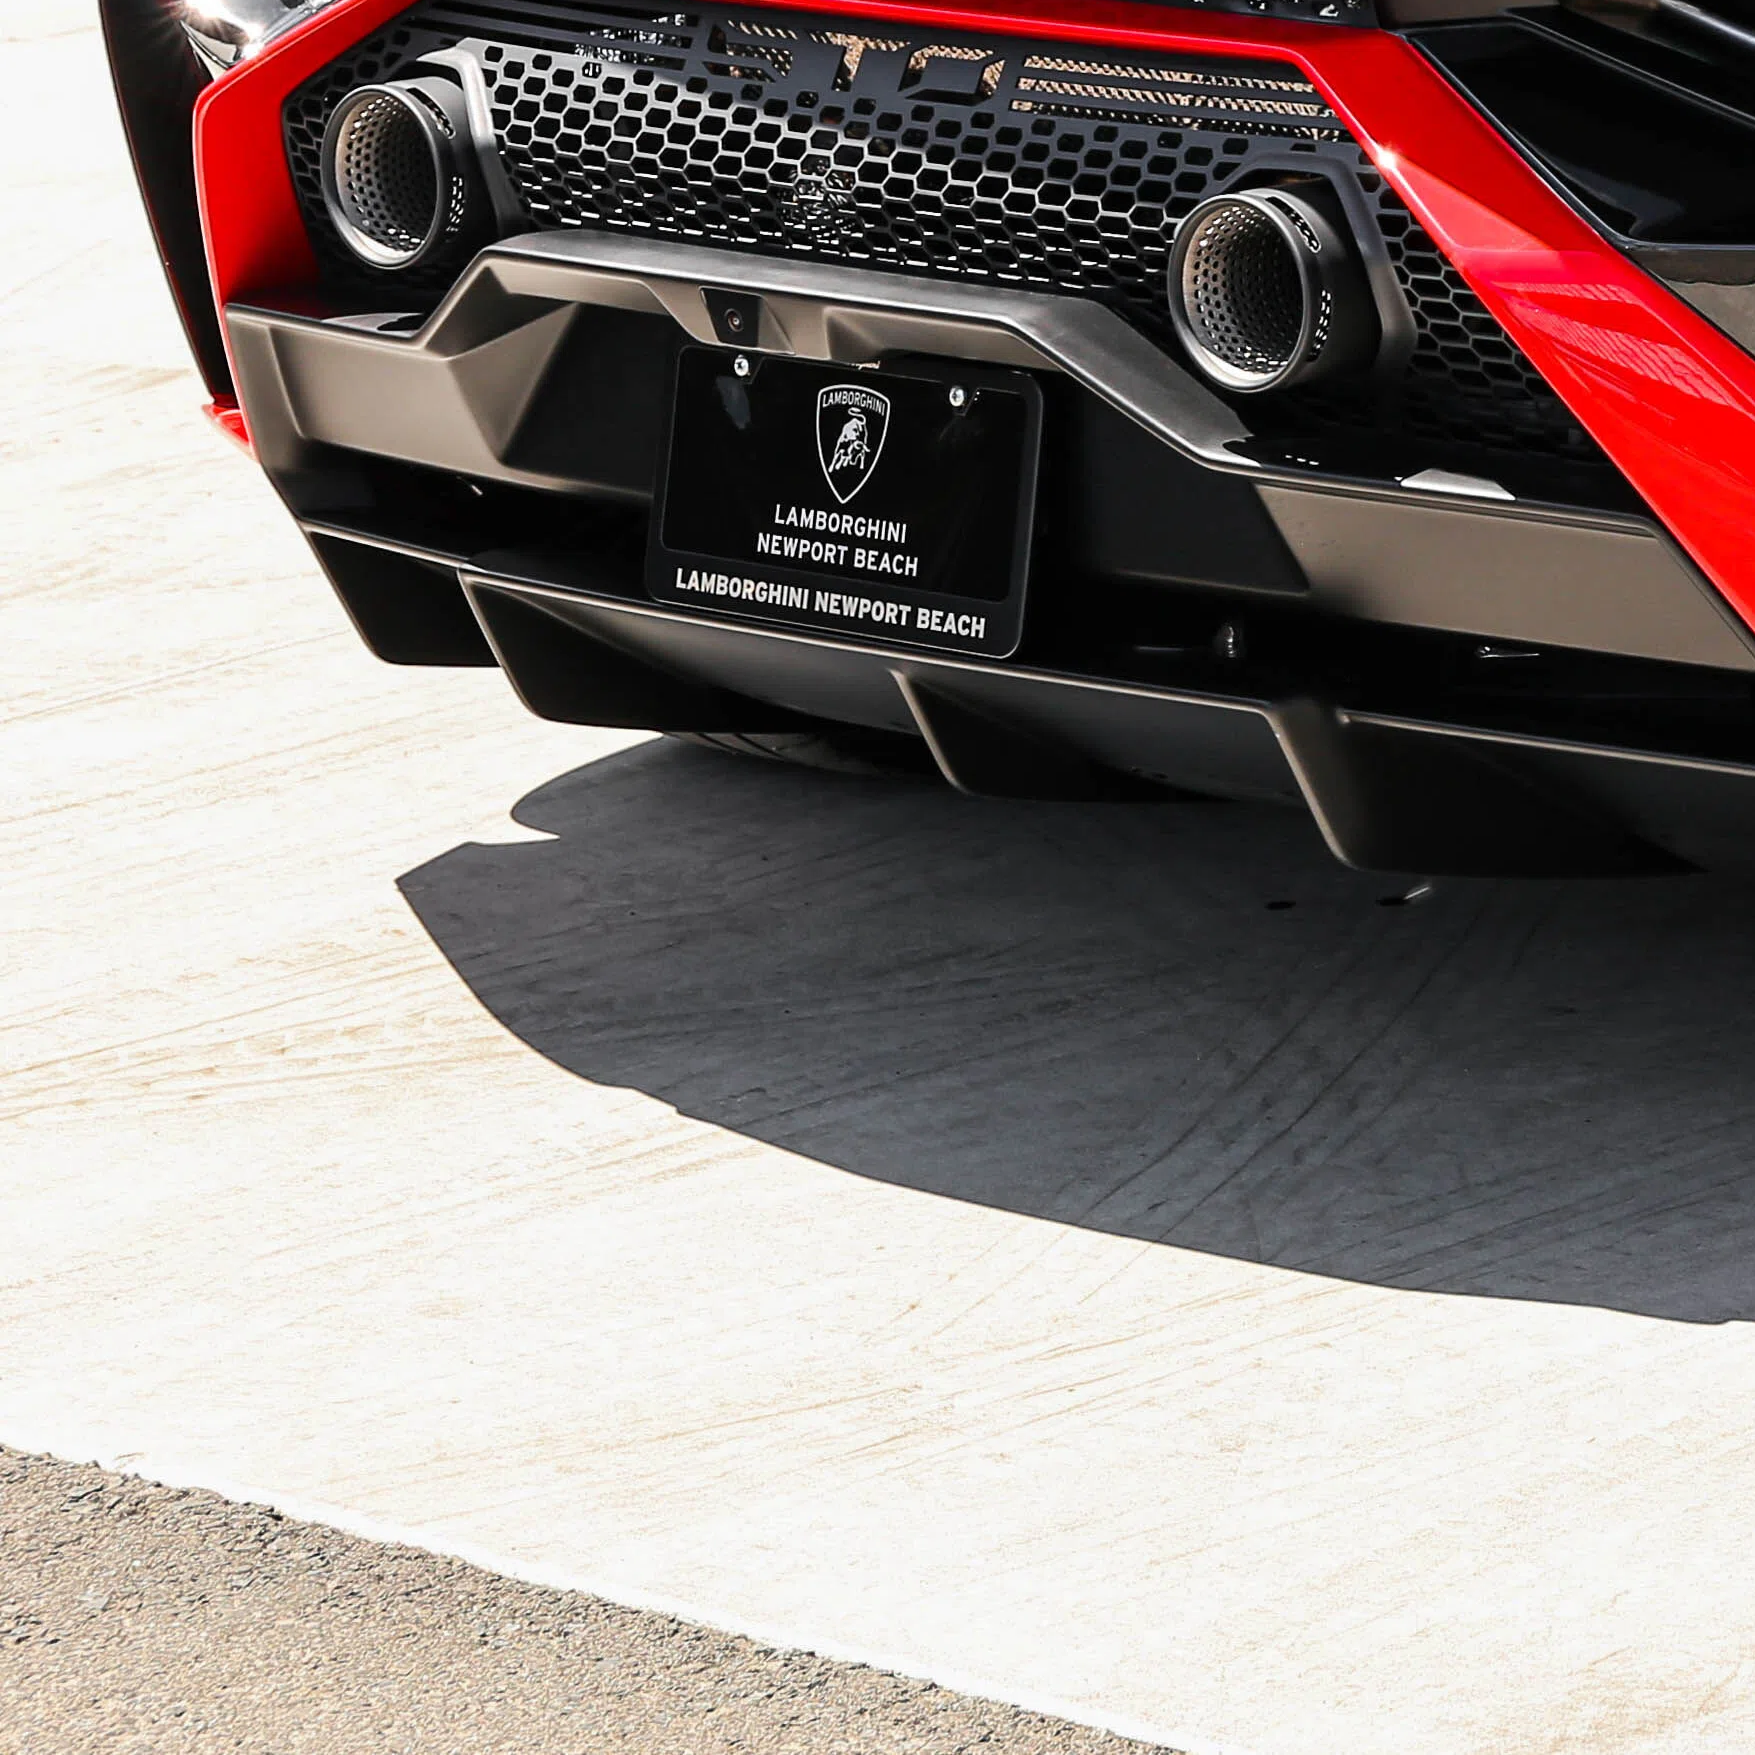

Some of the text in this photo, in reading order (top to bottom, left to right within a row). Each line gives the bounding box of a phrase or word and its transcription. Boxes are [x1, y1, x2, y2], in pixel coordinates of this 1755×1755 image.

[822, 391, 886, 416] LAMBORGHINI
[774, 503, 908, 544] LAMBORGHINI
[756, 532, 919, 577] NEWPORT BEACH
[675, 567, 986, 639] LAMBORGHINI NEWPORT BEACH
